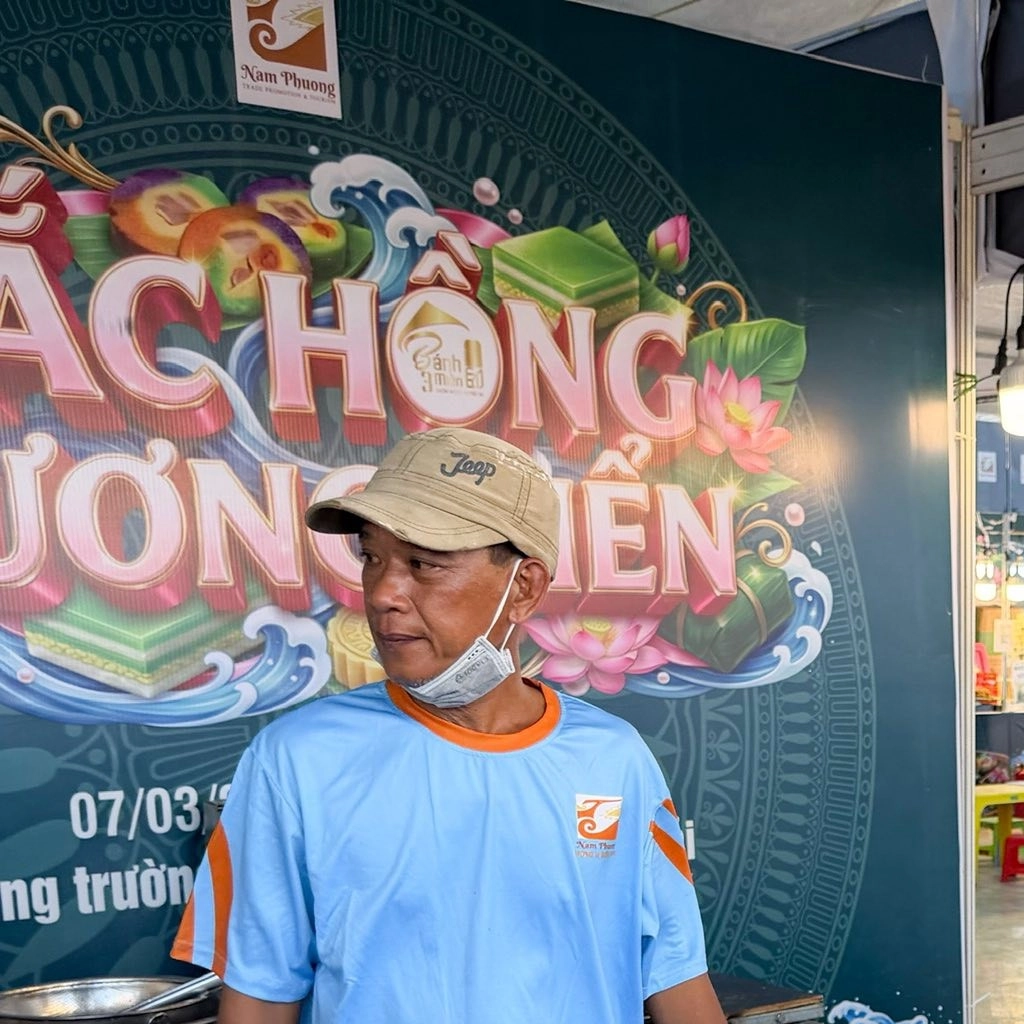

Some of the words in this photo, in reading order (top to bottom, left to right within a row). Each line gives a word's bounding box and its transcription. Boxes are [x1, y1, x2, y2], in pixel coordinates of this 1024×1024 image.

[241, 64, 277, 84] Nam
[280, 70, 336, 98] Phuong
[259, 231, 698, 442] HỒNG
[440, 451, 497, 486] Jeep
[548, 433, 738, 596] IỂN
[72, 858, 194, 914] trườn
